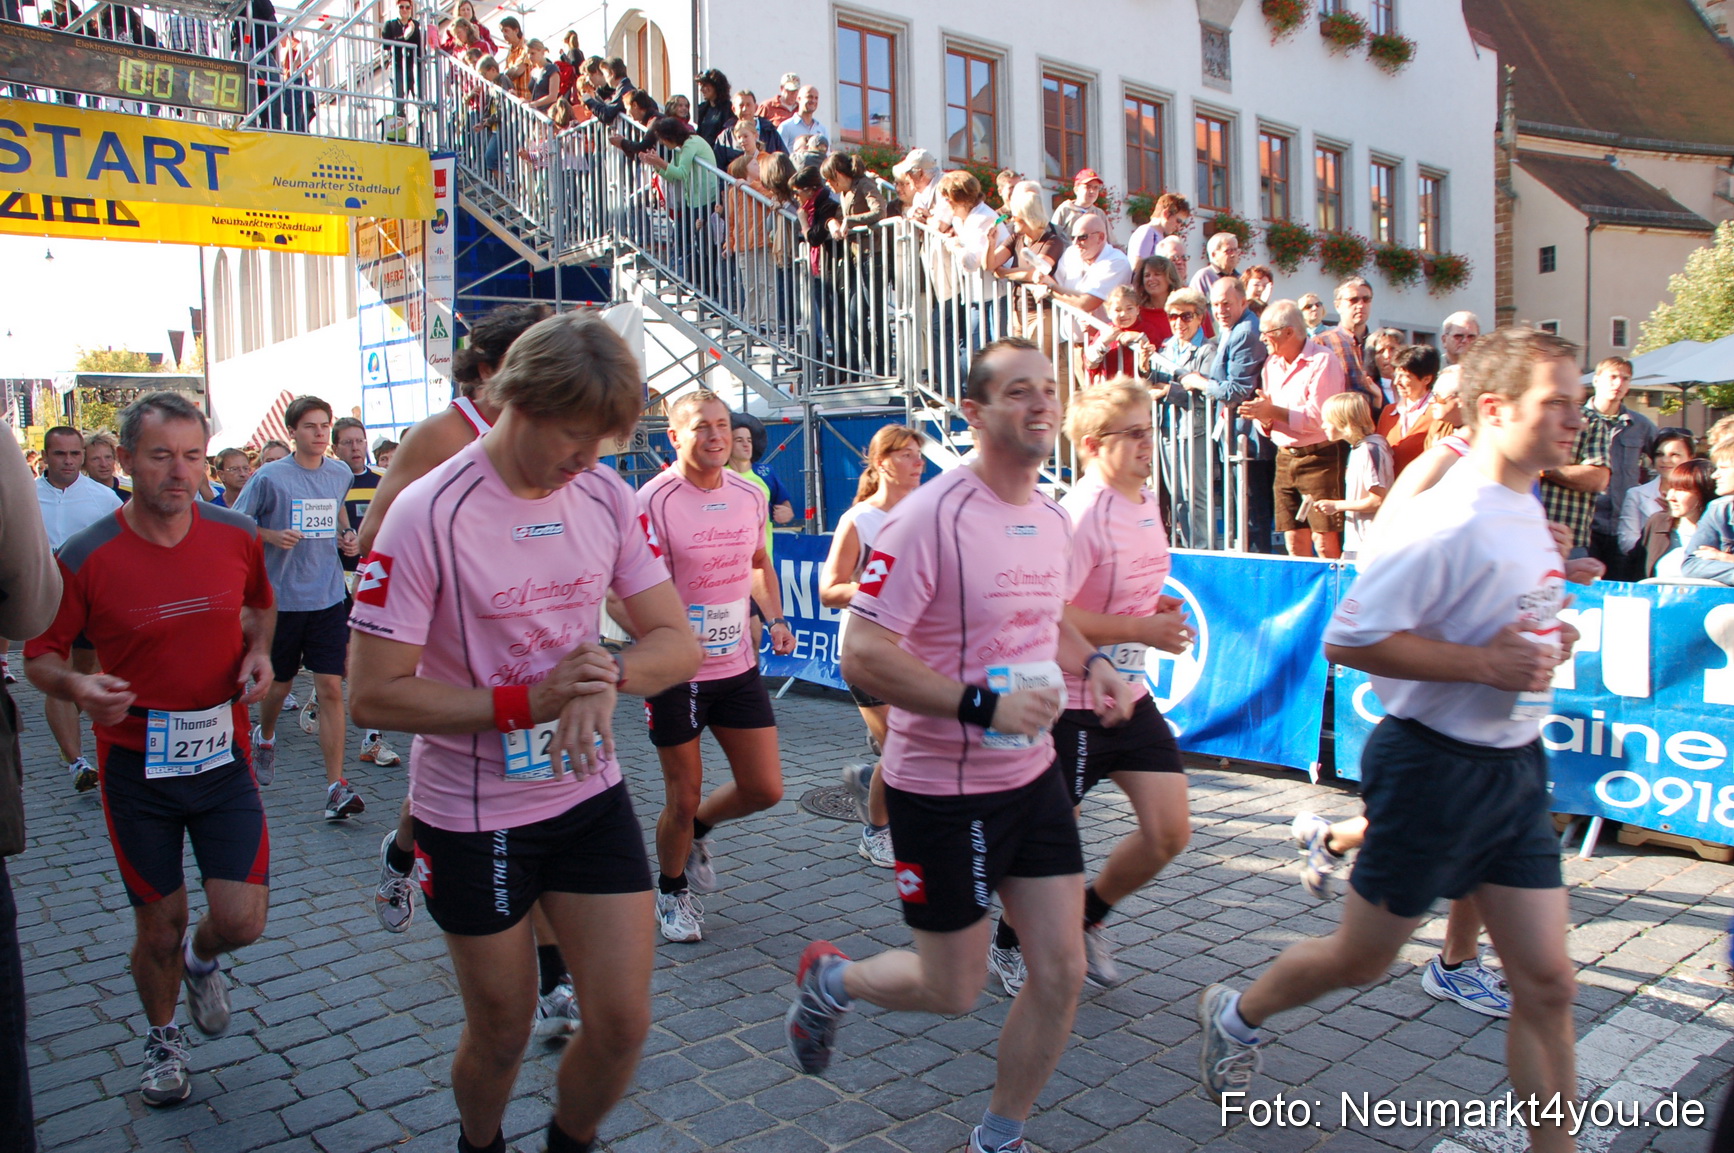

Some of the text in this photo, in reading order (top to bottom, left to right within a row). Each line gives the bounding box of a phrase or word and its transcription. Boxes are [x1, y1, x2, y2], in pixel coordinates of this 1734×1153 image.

[75, 40, 237, 73] Elektronische Sportstätteneinrichtungen
[0, 118, 230, 191] START
[273, 176, 401, 195] Neumarkter Stadtlauf
[211, 216, 323, 232] Neumarkter Stadtlauf
[304, 502, 333, 512] Christoph
[305, 516, 333, 528] 2349
[707, 609, 730, 621] Ralph
[174, 717, 218, 731] Thomas
[150, 731, 227, 758] B 2714
[1076, 756, 1087, 774] THE
[1074, 775, 1086, 798] JOIN
[493, 859, 507, 885] THE
[971, 855, 987, 882] THE
[493, 888, 511, 916] JOIN
[974, 882, 990, 909] JOIN
